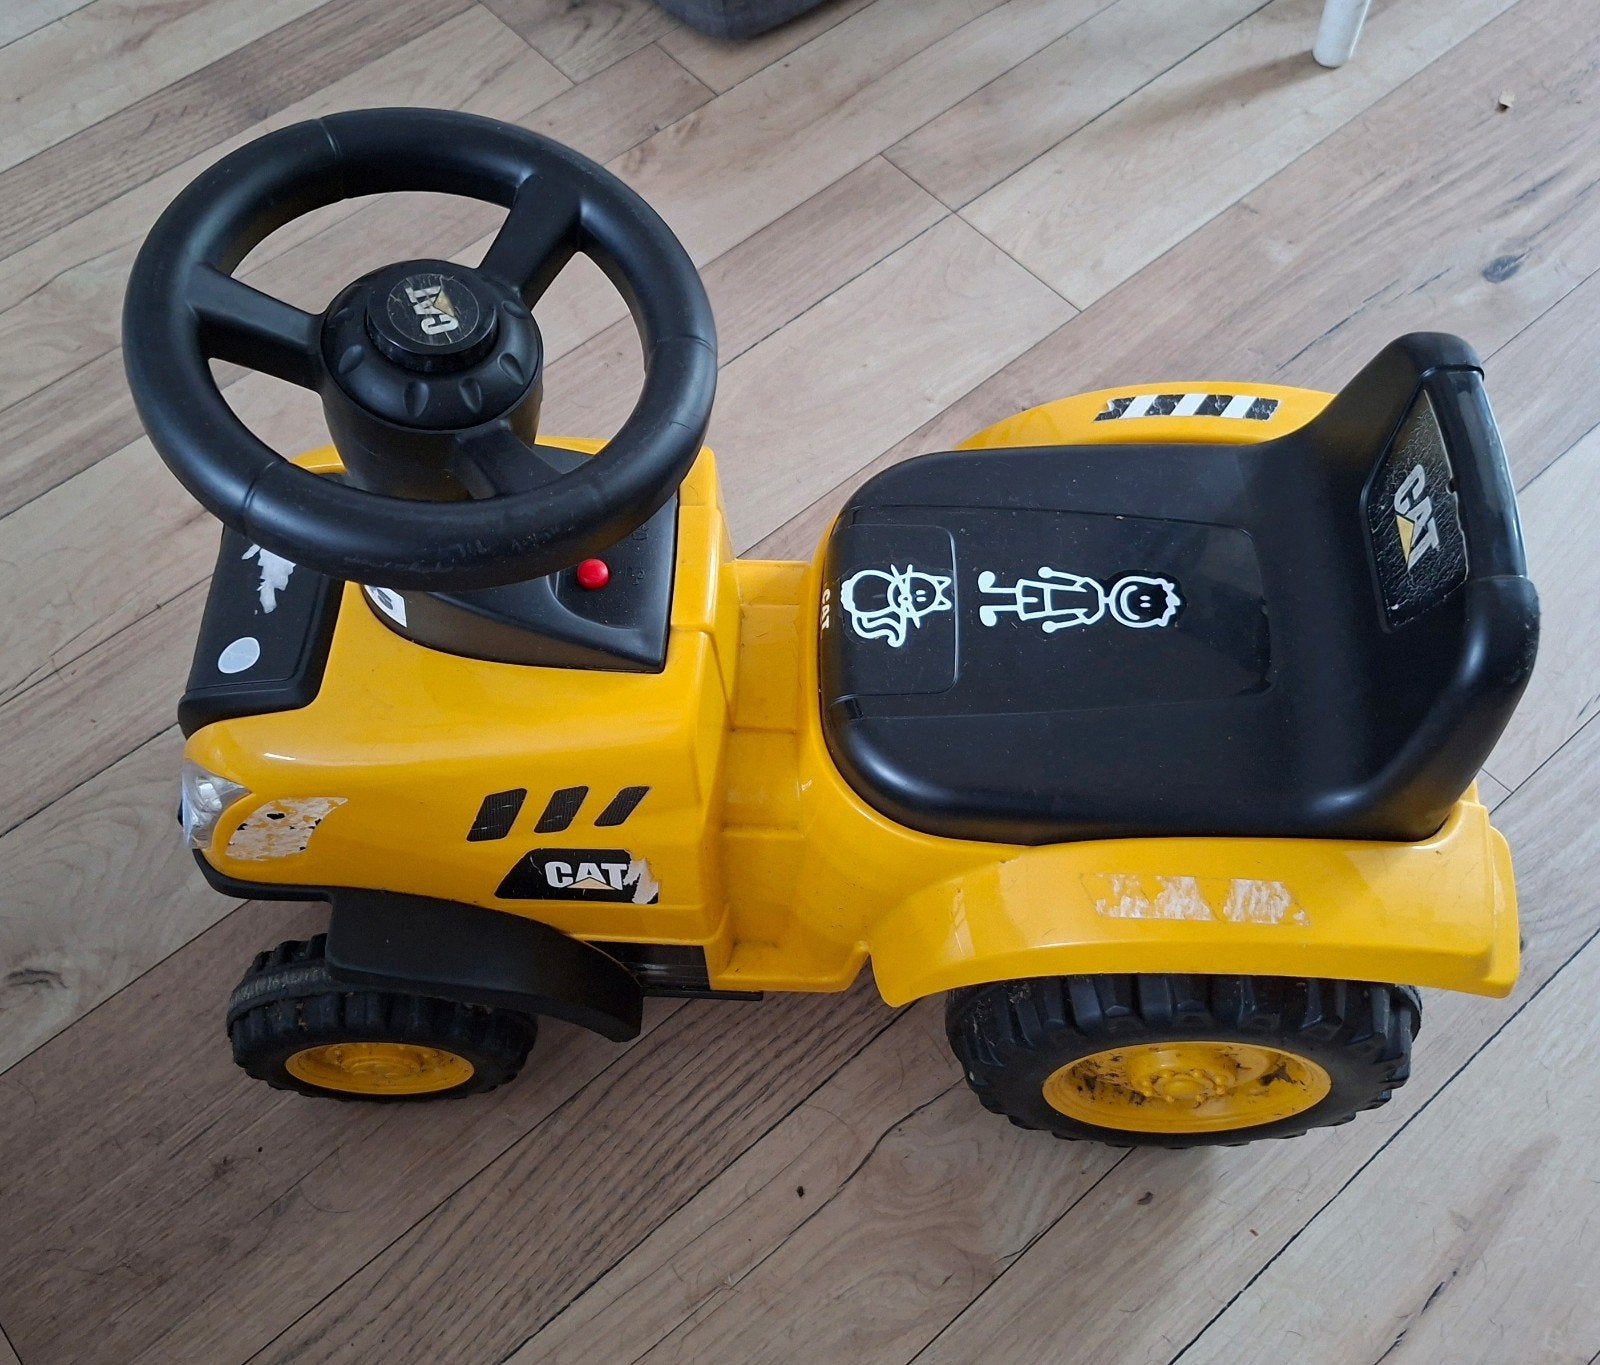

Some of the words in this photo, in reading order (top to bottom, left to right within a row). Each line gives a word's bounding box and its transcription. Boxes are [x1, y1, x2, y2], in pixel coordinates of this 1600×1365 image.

[404, 285, 460, 335] CAT
[1393, 463, 1440, 572] CAT
[820, 587, 832, 631] CAT
[544, 861, 628, 891] CAT
